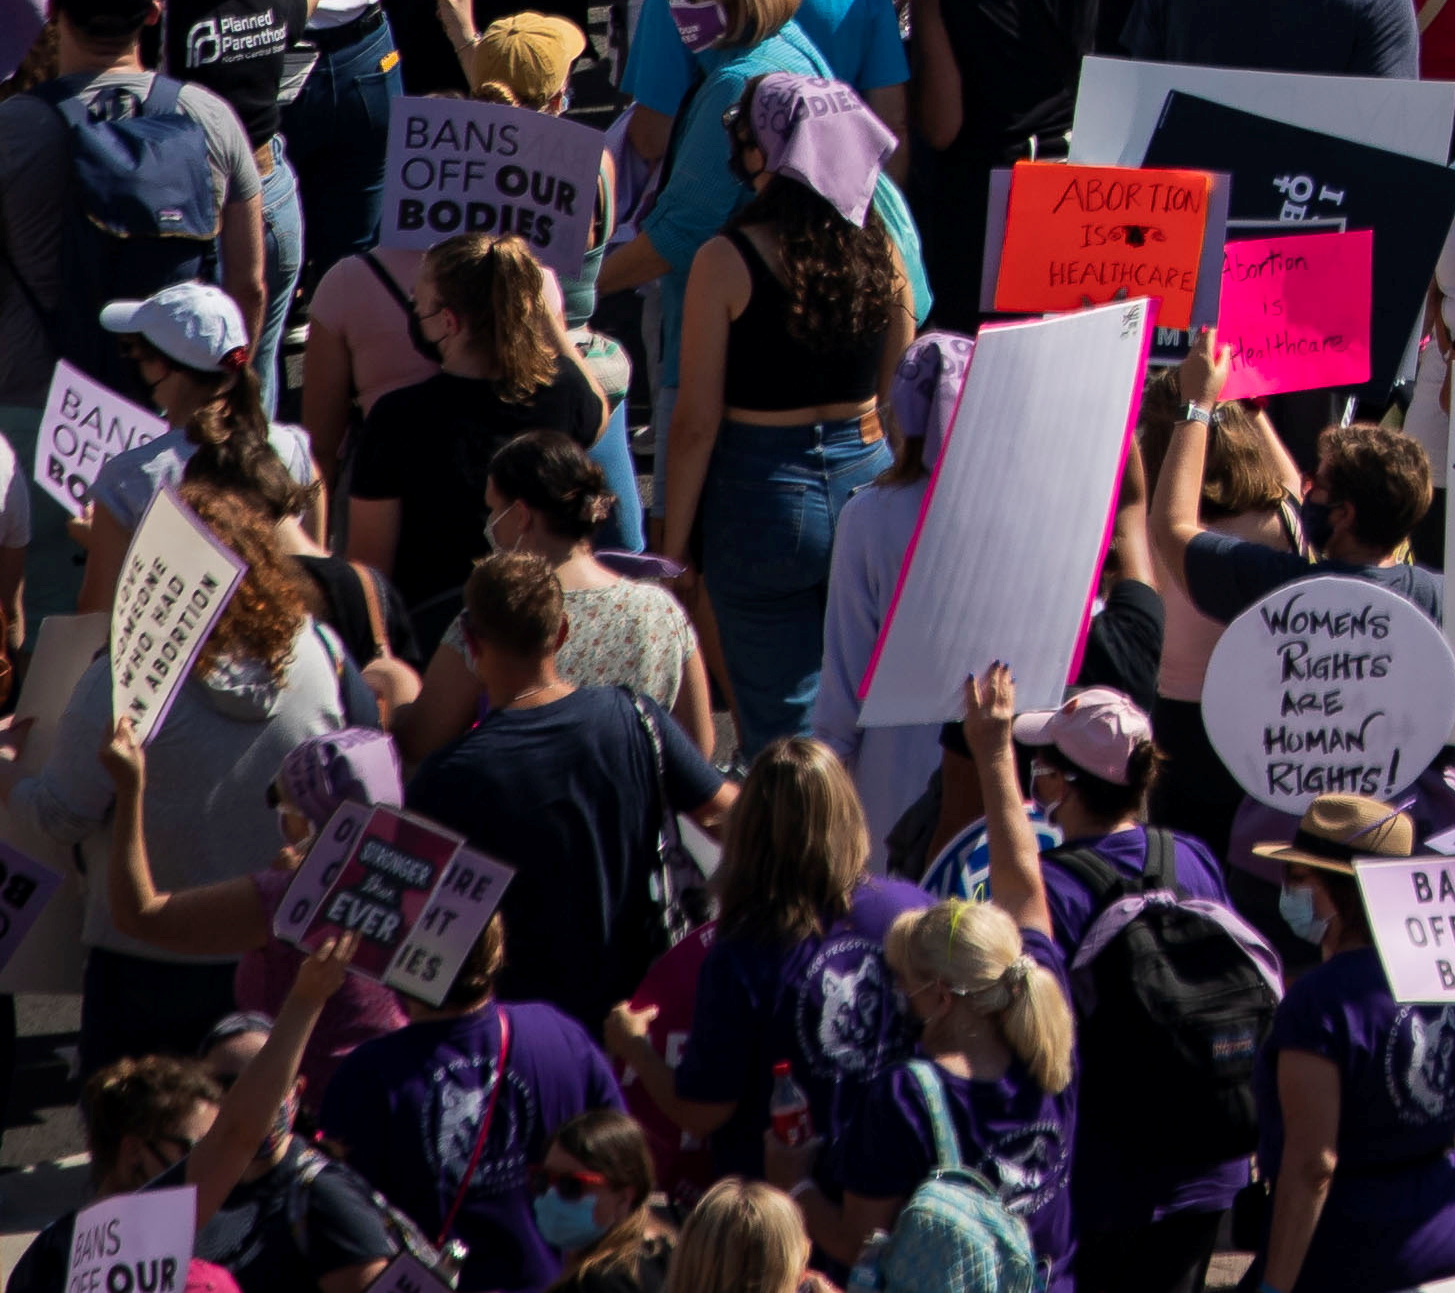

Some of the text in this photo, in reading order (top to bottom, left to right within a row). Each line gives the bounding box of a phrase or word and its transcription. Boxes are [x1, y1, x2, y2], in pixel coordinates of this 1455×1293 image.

[221, 8, 273, 34] Planned
[1260, 592, 1390, 640] WOMENS
[1277, 641, 1392, 683] RIGHTS
[1280, 687, 1343, 716] ARE
[1263, 712, 1384, 755] HUMAN
[1266, 748, 1400, 796] RIGHTS!
